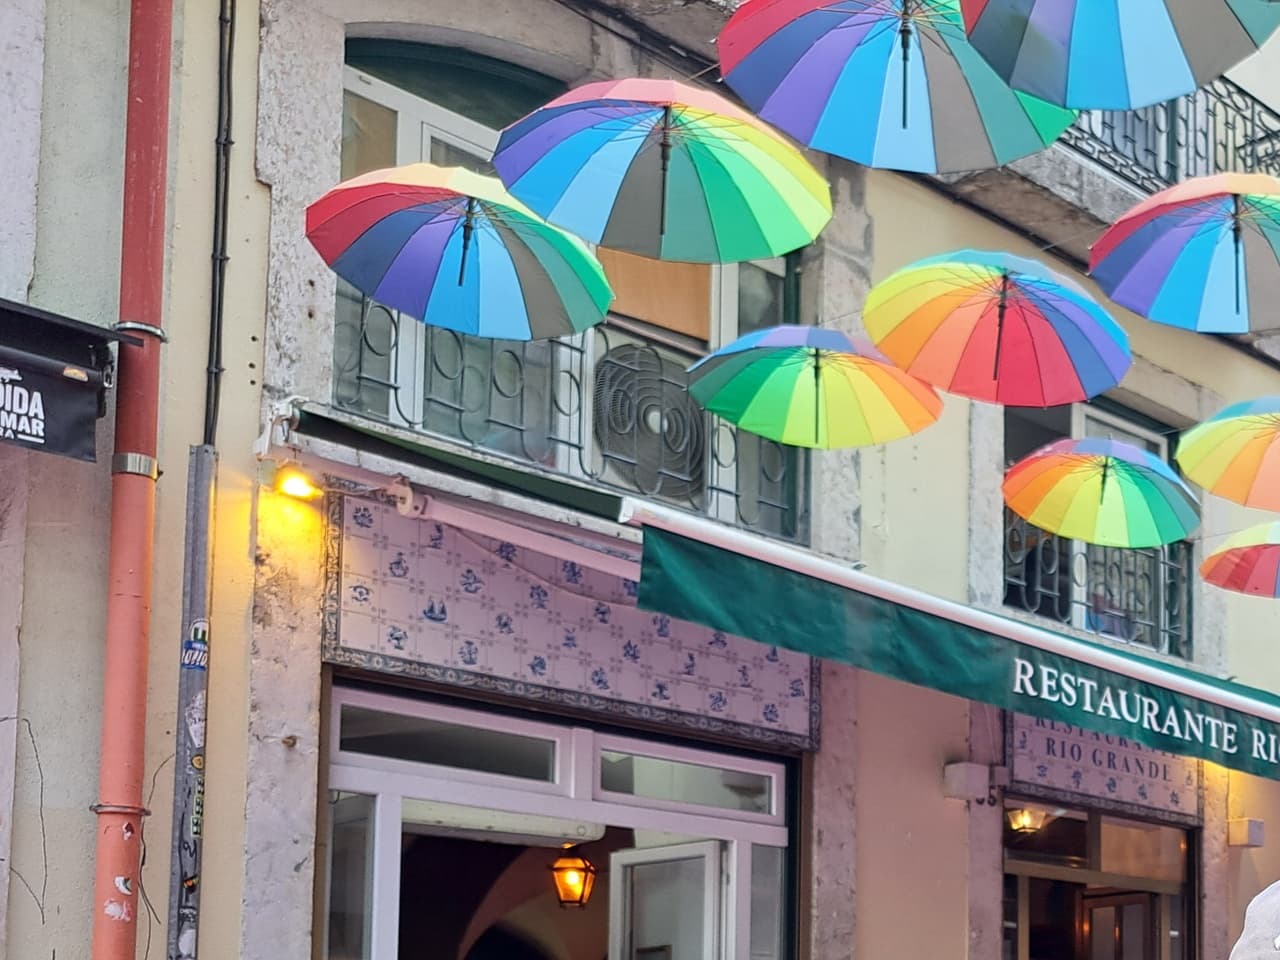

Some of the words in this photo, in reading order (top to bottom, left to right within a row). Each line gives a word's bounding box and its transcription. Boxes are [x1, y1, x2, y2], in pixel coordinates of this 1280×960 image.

[1012, 657, 1239, 755] RESTAURANTE
[1046, 737, 1082, 762] RIO
[1092, 747, 1173, 783] GRANDE
